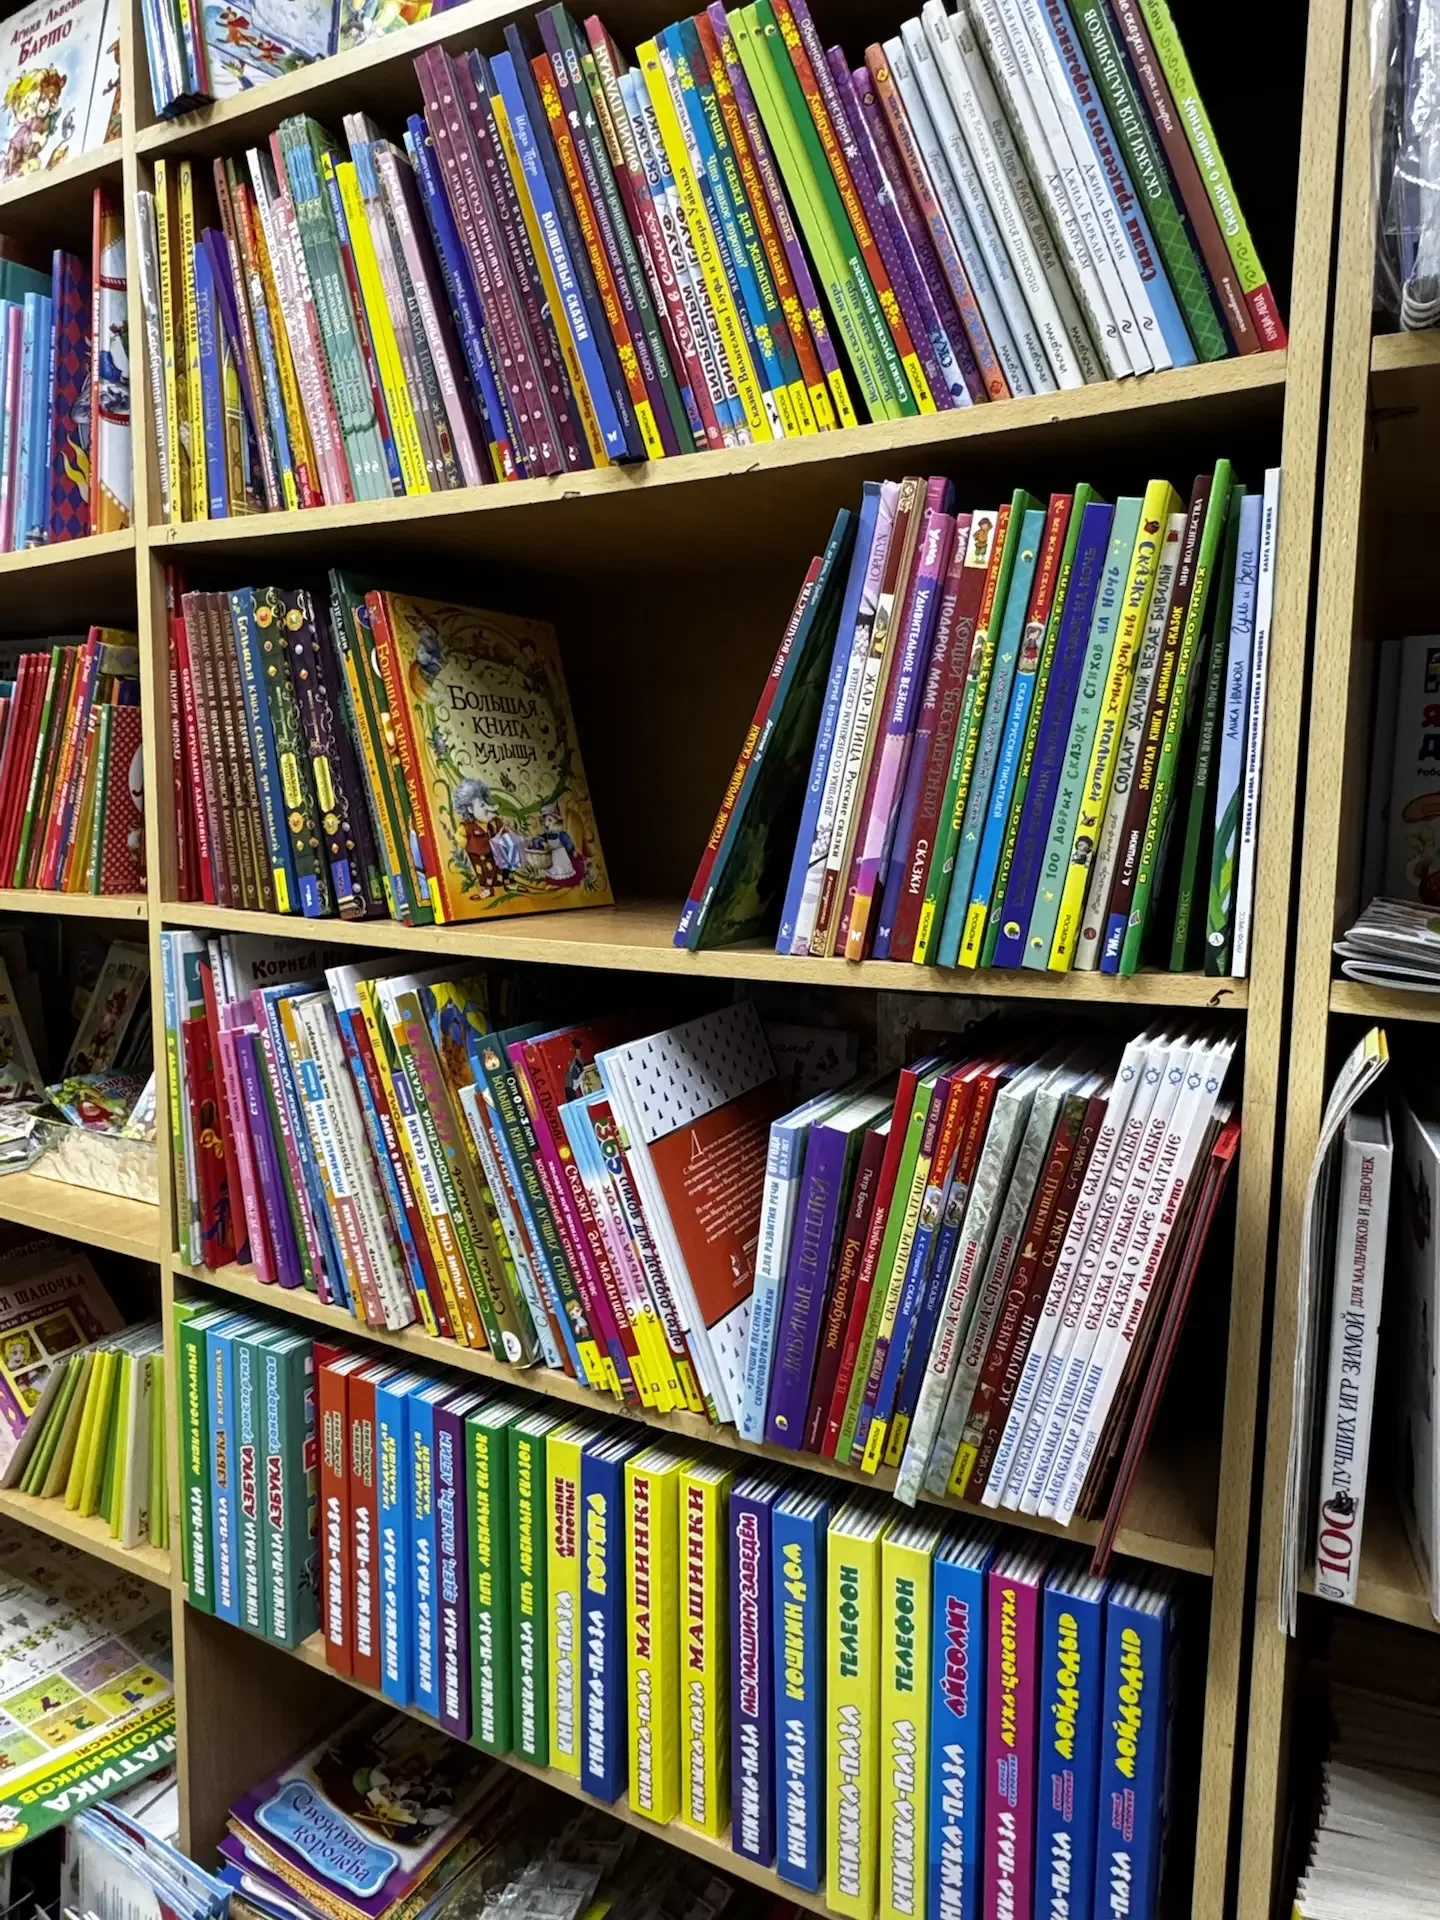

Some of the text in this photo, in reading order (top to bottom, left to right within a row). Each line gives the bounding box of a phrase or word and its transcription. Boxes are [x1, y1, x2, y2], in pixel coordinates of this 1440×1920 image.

[592, 41, 642, 174] ФИЛИП ПУЛМАН
[806, 89, 873, 250] Любимая книга малышей
[1080, 6, 1164, 200] СКАЗКИ ДЛЯ МАЛЬЧИКОВ
[1178, 93, 1242, 237] Сказки о животных
[698, 90, 780, 313] Лучшие сказки для малышей
[743, 110, 796, 244] Первые русские сказки
[1044, 169, 1093, 271] ДЖИЛЛ БАРКЛЕМ
[1081, 160, 1129, 261] ДЖИЛЛ БАРКЛЕМ
[156, 211, 173, 341] НОВОЕ ПЛАТЬЕ КОРОЛЯ
[539, 208, 574, 292] ВОЛШЕБНЫЕ
[564, 292, 589, 342] СКАЗКИ
[628, 112, 725, 404] ВИЛЬГЕЛЬМ ГАУФ СКАЗКИ
[675, 164, 764, 429] Сказки Вильгельма Гауфа и Оскара Уайльда
[846, 253, 910, 404] Сказки русских писателей
[1176, 495, 1205, 588] МИР ВОЛШЕБСТВА
[447, 684, 538, 719] БОЛЬШАЯ
[889, 587, 931, 724] УДИВИТЕЛЬНОЕ ВЕЗЕНИЕ
[921, 592, 957, 711] ПОДАРОК МАМЕ
[1020, 562, 1072, 778] ЖИВОТНЫЙ МИР ЗЕМЛИ
[1137, 604, 1184, 791] ЗОЛОТАЯ КНИГА ЛЮБИМЫХ СКАЗОК
[1161, 563, 1209, 754] В МИРЕ ЖИВОТНЫХ
[369, 640, 431, 839] БОЛЬШАЯ КНИГА МАЛЫША
[472, 716, 532, 740] КНИГА
[473, 741, 538, 767] МАЛЫША
[706, 721, 763, 851] РУССКИЕ НАРОДНЫЕ СКАЗКИ
[809, 662, 847, 793] Сказки Золотой рыбки
[828, 671, 880, 859] ЖАР-ПТИЦА Русские сказки
[947, 725, 983, 830] ЛЮБИМЫЕ
[969, 638, 998, 718] СКАЗКИ
[988, 680, 1029, 820] СКАЗКИ РУССКИХ ПИСАТЕЛЕЙ
[905, 837, 930, 896] СКАЗКИ
[256, 1026, 295, 1136] КРУГЛЫЙ ГОД
[338, 1201, 372, 1286] ПЕРВЫЕ СКАЗКИ
[448, 1162, 509, 1317] Сергей Михалков
[490, 1073, 577, 1298] БОЛЬШАЯ КНИГА САМЫХ ЛУЧШИХ СТИХОВ
[562, 1161, 631, 1332] Сказки для малышей
[578, 1185, 646, 1328] КОТЕНЬКА-КОТОК
[760, 1179, 781, 1276] ДЛЯ РАЗВИТИЯ РЕЧИ
[1040, 1122, 1120, 1319] СКАЗКА О ЦАРЕ САЛТАНЕ
[1059, 1115, 1146, 1331] СКАЗКА О РЫБАКЕ И РЫБКЕ
[1347, 1154, 1377, 1308] ДЛЯ МАЛЬЧИКОВ И ДЕВОЧЕК
[13, 1272, 87, 1307] ШАПОЧКА
[434, 1216, 469, 1301] ЛУЧШИЕ СТИХИ
[819, 1237, 863, 1351] Конёк-горбунок
[931, 1237, 981, 1375] Сказки А.С.Пушкина
[989, 1287, 1027, 1355] Сказки
[379, 1421, 392, 1511] ЗАГАДКИ ДЛЯ
[386, 1434, 399, 1504] МАЛЫШЕЙ
[982, 1350, 1045, 1493] АЛЕКСАНДР ПУШКИН
[1330, 1308, 1367, 1492] ЛУЧШИХ ИГР ЗИМОЙ
[435, 1428, 465, 1720] КНИЖКА-ПАЗЛ ЕДЕМ, ПЛЫВЁМ, ЛЕТИМ
[471, 1430, 501, 1743] КНИЖКА-ПАЗЛ ПЯТЬ ЛЮБИМЫХ СКАЗОК
[552, 1476, 567, 1558] ДОМАШНИЕ
[562, 1480, 578, 1557] ЖИВОТНЫЕ
[378, 1526, 403, 1681] КНИЖКА-ПАЗЛ
[583, 1491, 610, 1778] КНИЖКА-ПАЗЛ КОТЯТА
[681, 1484, 711, 1824] КНИЖКА-ПАЗЛ МАШИНКИ
[938, 1593, 971, 1718] АЙБОЛИТ
[991, 1587, 1025, 1747] МУХА-ЦОКОТУХА
[780, 1541, 812, 1869] КНИЖКА-ПАЗЛ КОШКИН ДОМ
[834, 1563, 864, 1897] КНИЖКА-ПАЗЛ ТЕЛЕФОН
[1048, 1611, 1085, 1760] МОЙДОДЫР
[1109, 1626, 1148, 1778] МОЙДОДЫР
[292, 1794, 367, 1855] Снежная
[293, 1825, 370, 1882] королева
